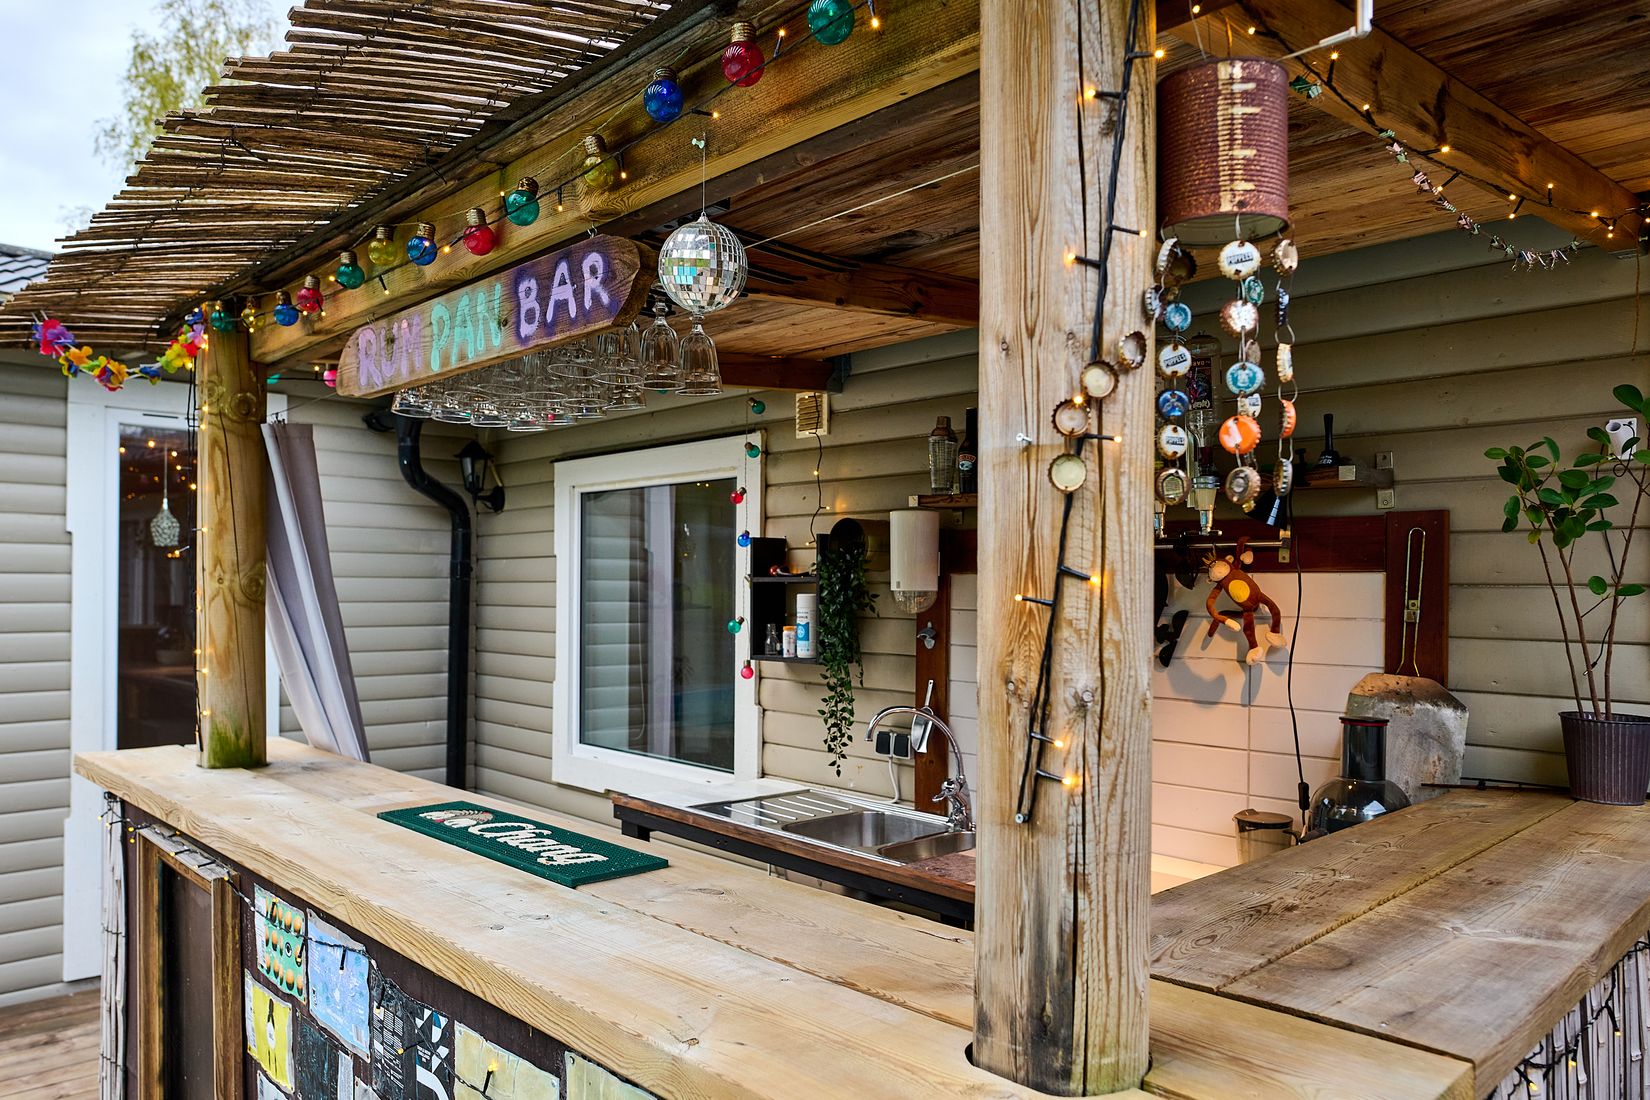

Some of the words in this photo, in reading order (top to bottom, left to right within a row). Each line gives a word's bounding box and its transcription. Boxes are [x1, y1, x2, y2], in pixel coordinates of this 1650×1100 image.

[358, 313, 423, 389] RUM
[430, 281, 502, 372] PAN
[518, 251, 612, 340] BAR
[467, 821, 610, 866] Chang
